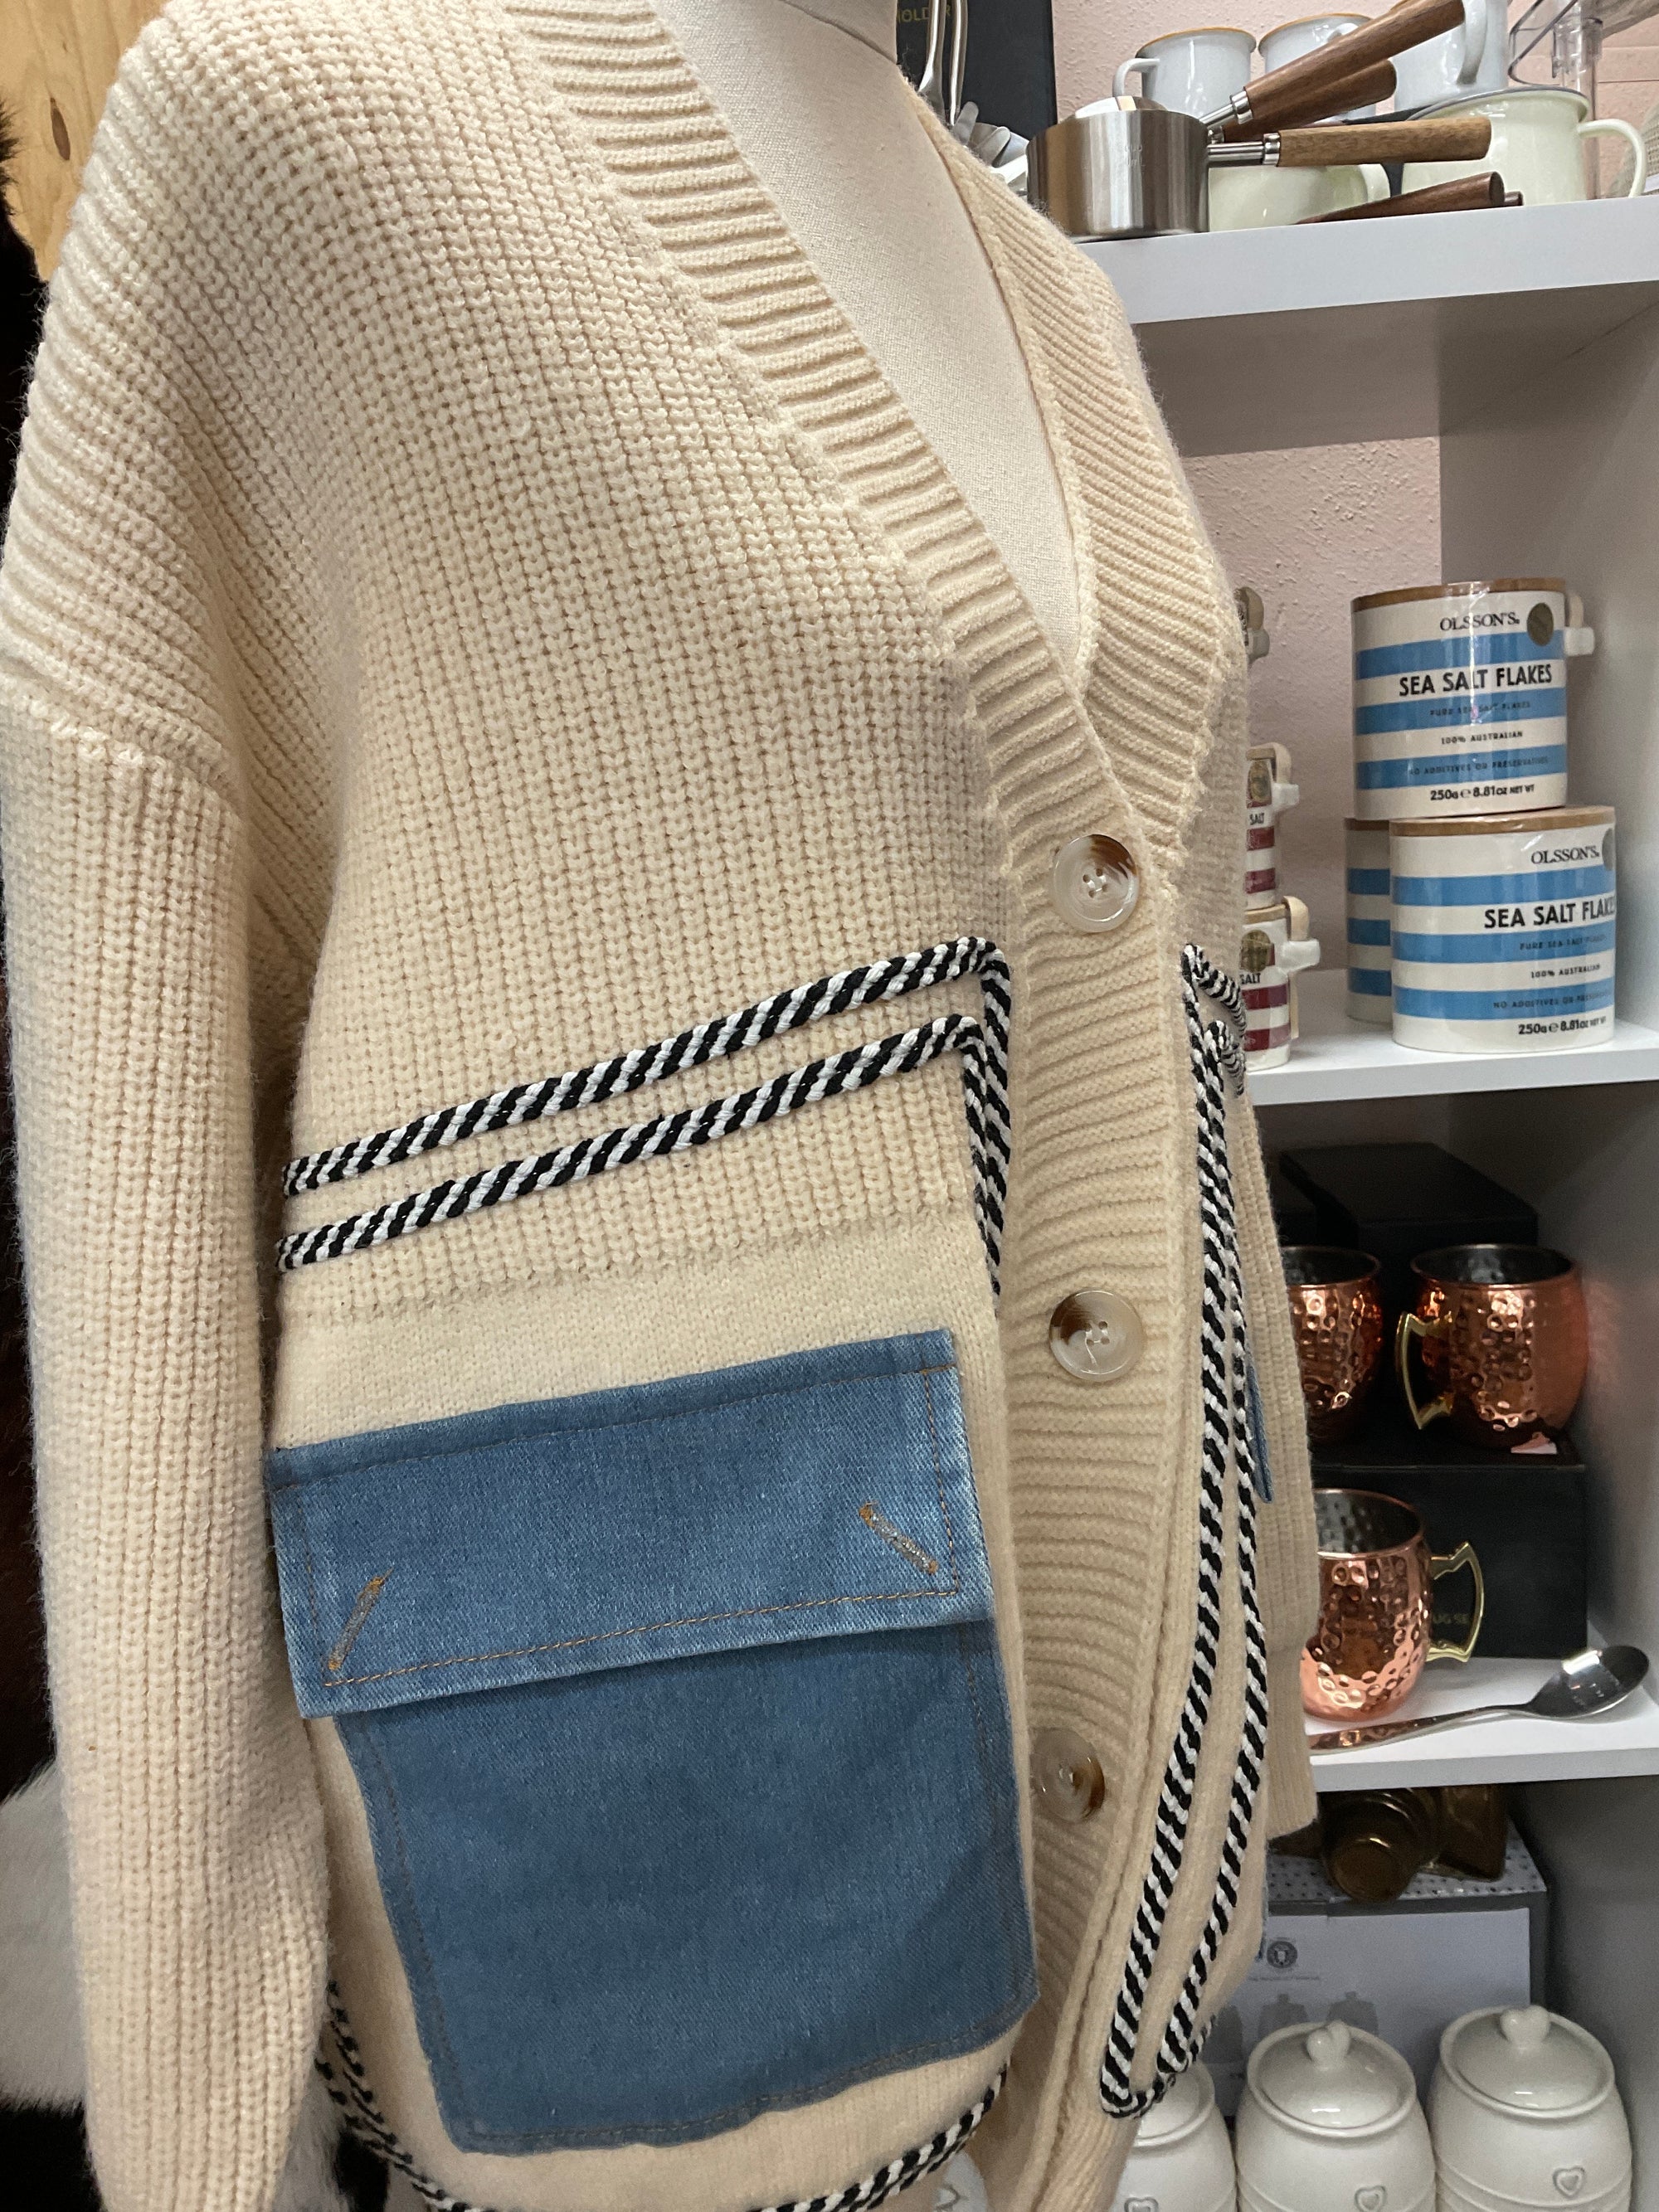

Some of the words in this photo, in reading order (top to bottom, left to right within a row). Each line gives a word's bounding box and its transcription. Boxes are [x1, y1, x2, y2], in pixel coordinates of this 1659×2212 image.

[898, 4, 951, 23] OLDR
[1399, 674, 1436, 698] SEA
[1443, 668, 1488, 692] SALT
[1496, 664, 1552, 688] FLAKES
[1441, 735, 1467, 745] 100%
[1471, 731, 1523, 742] AUSTRALIAN
[1509, 785, 1524, 795] NET
[1249, 812, 1265, 826] SALT
[1531, 845, 1599, 864] OLSSON'S
[1484, 907, 1525, 929] SEA
[1533, 902, 1576, 926] SALT
[1520, 942, 1543, 951] PURE
[1530, 970, 1555, 980] 100%
[1559, 963, 1600, 975] AUSTRALIAN
[1493, 1001, 1507, 1009] NO
